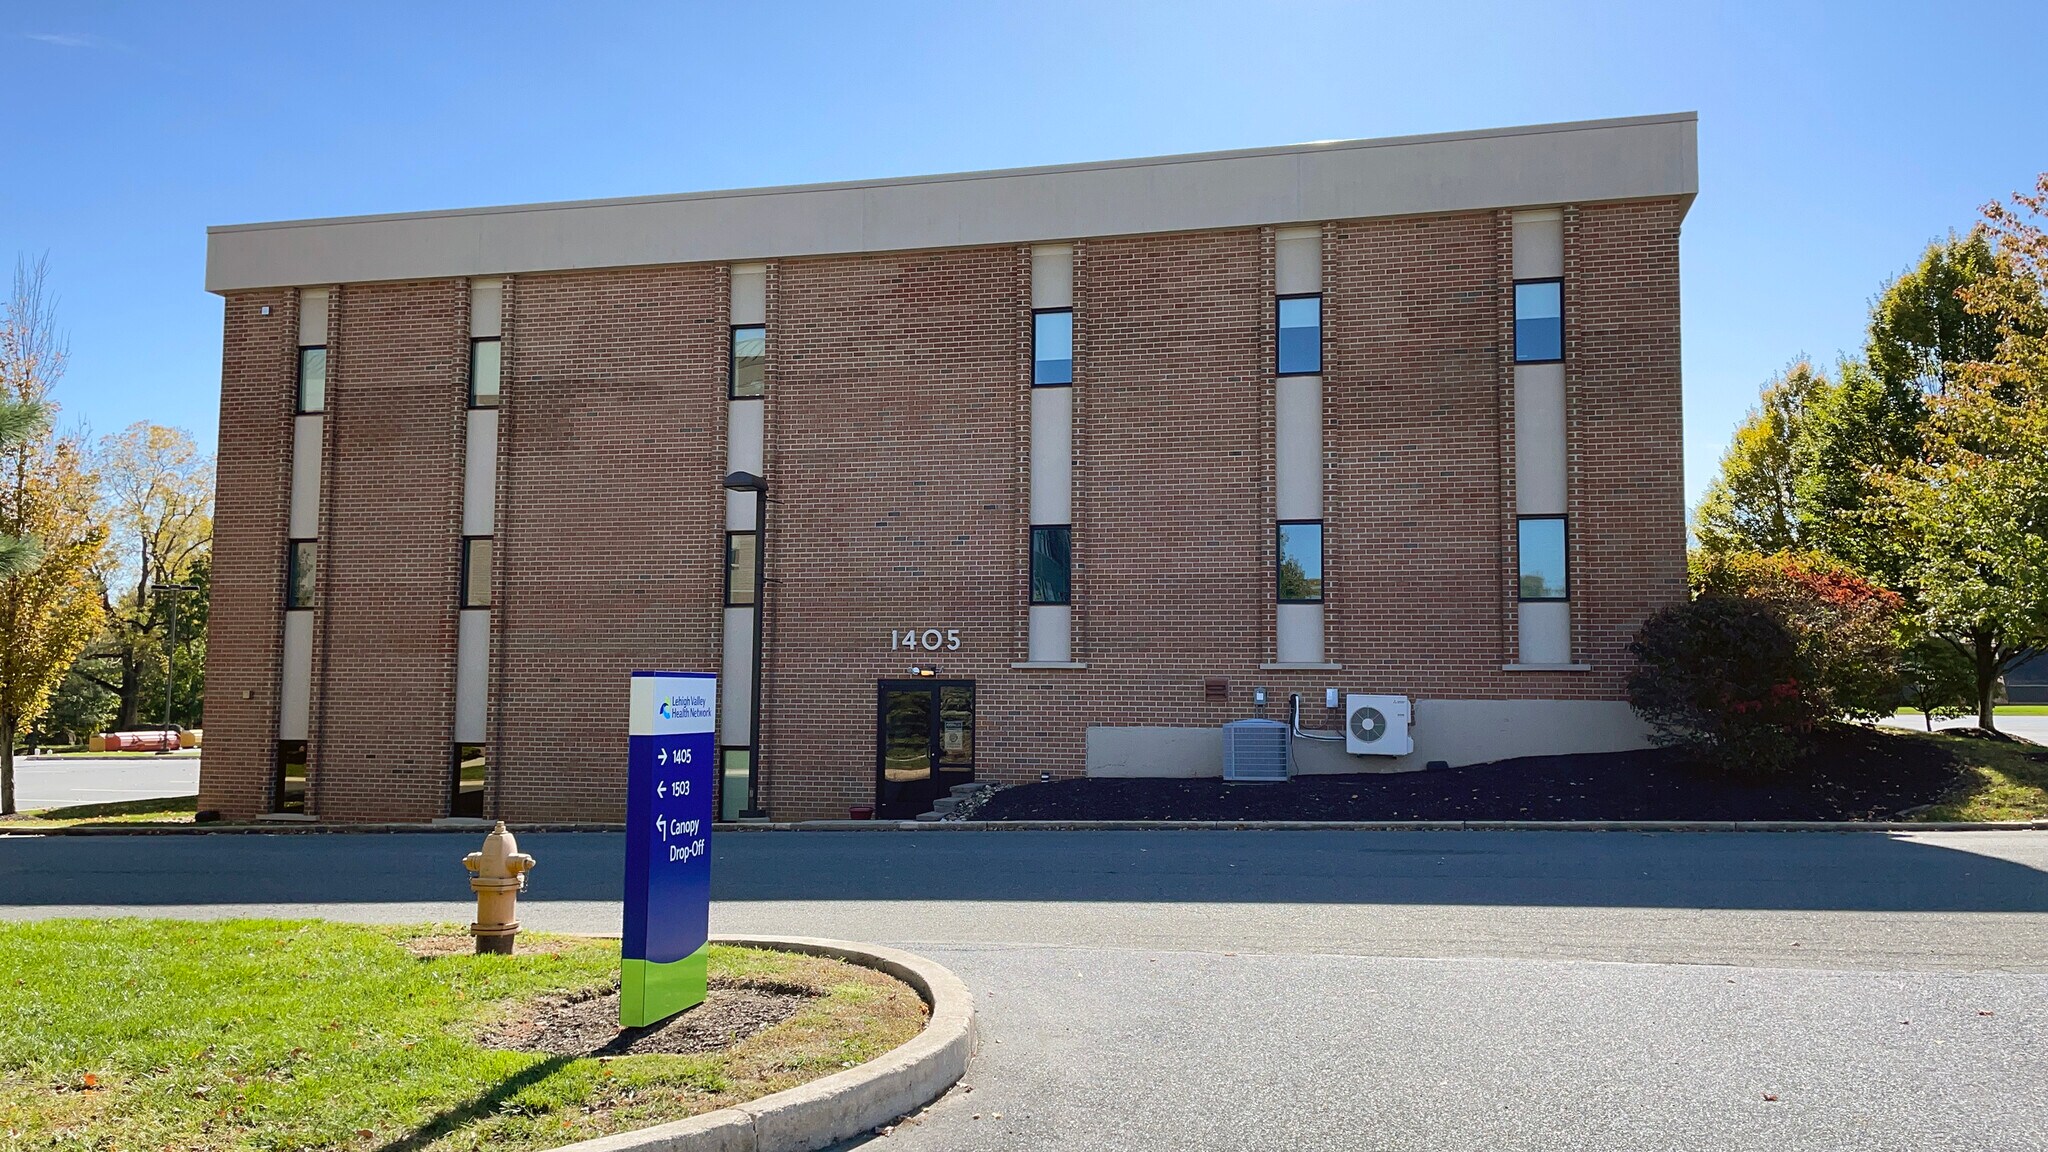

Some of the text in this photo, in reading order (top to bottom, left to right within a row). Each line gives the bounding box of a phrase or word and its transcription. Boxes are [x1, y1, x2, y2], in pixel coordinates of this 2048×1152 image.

[891, 629, 960, 651] 1405
[672, 696, 706, 708] Lehigh Valley
[671, 707, 711, 718] Health Network
[672, 748, 692, 764] 1405
[671, 780, 690, 797] 1503
[670, 818, 700, 836] Canopy
[669, 838, 705, 863] Drop-Off
